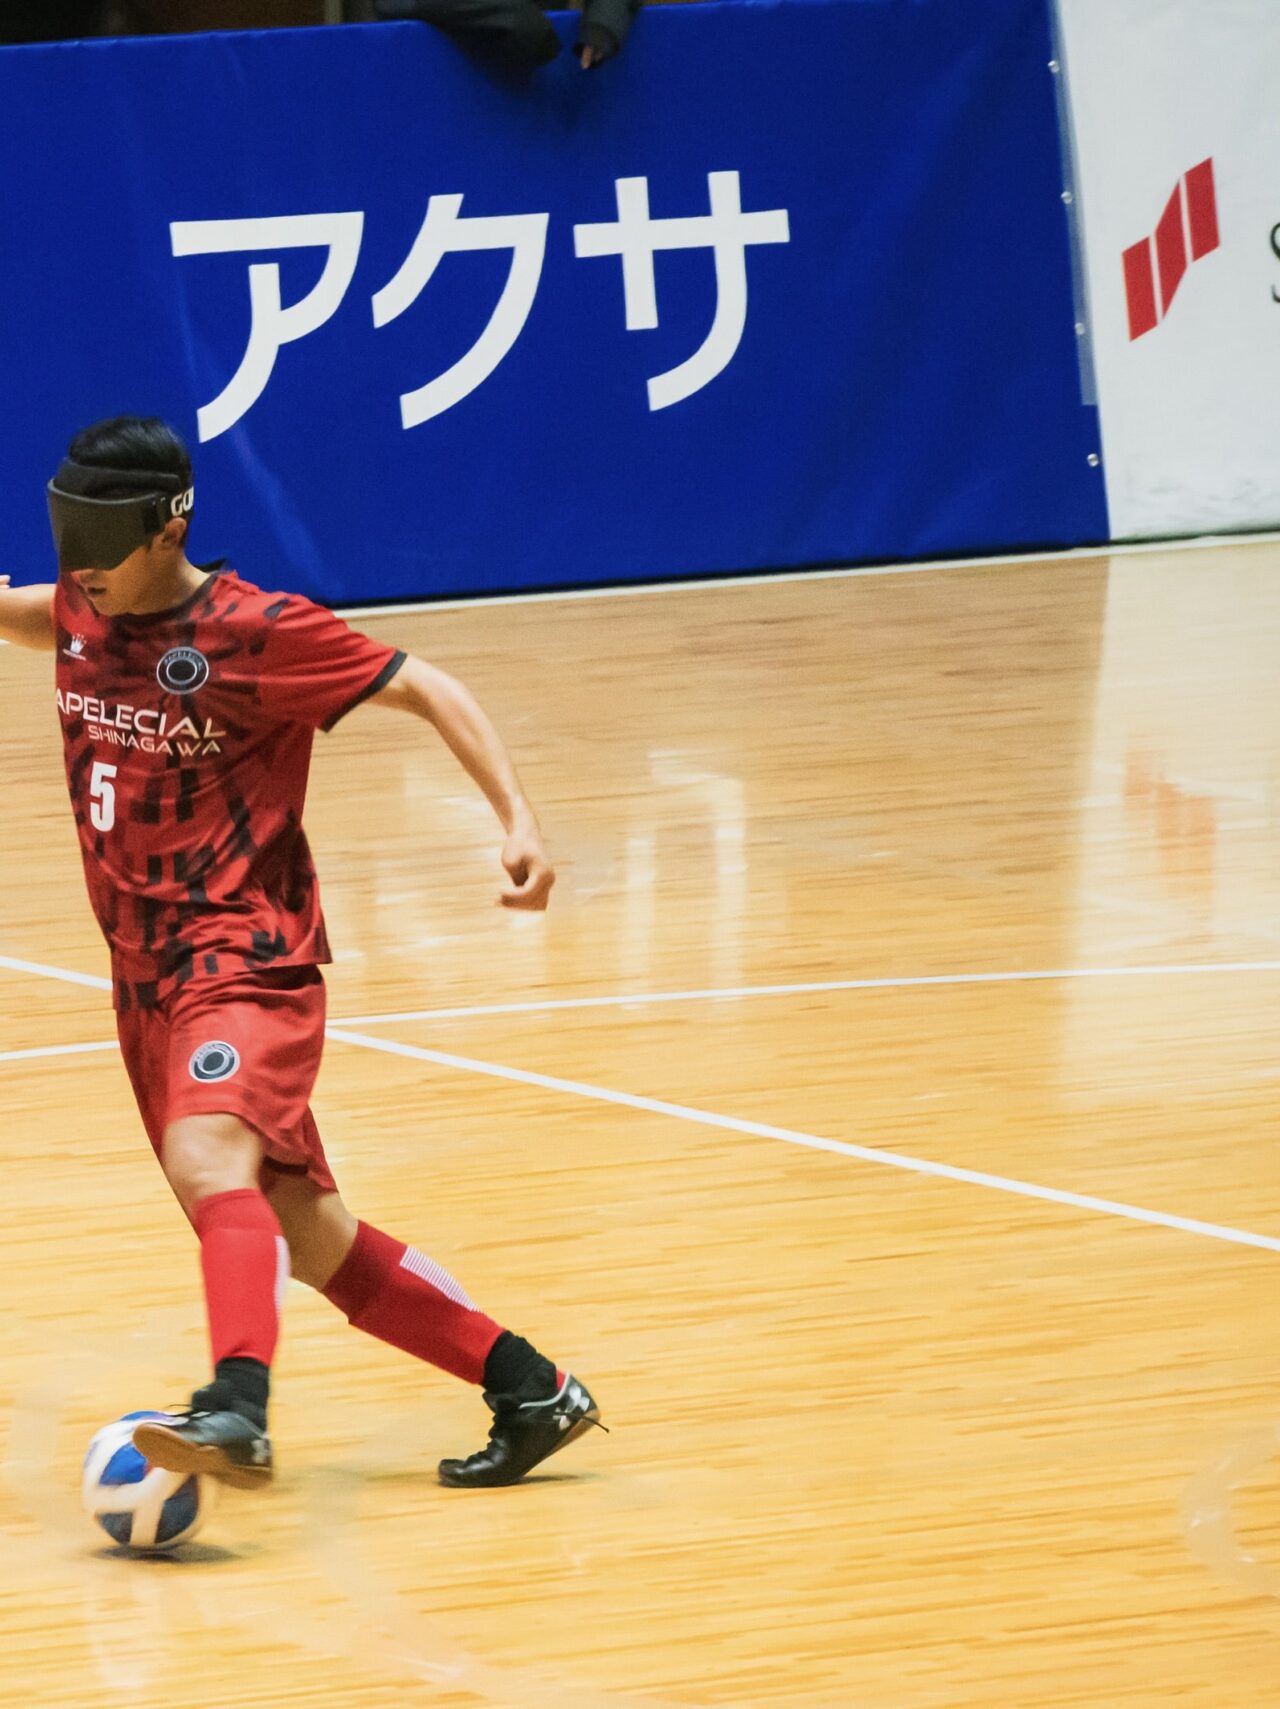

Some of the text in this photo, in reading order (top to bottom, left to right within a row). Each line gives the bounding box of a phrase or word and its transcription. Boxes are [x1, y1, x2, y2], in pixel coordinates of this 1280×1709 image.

[170, 170, 790, 443] アクサ
[88, 725, 220, 757] SHINAGAWA
[89, 761, 117, 832] 5
